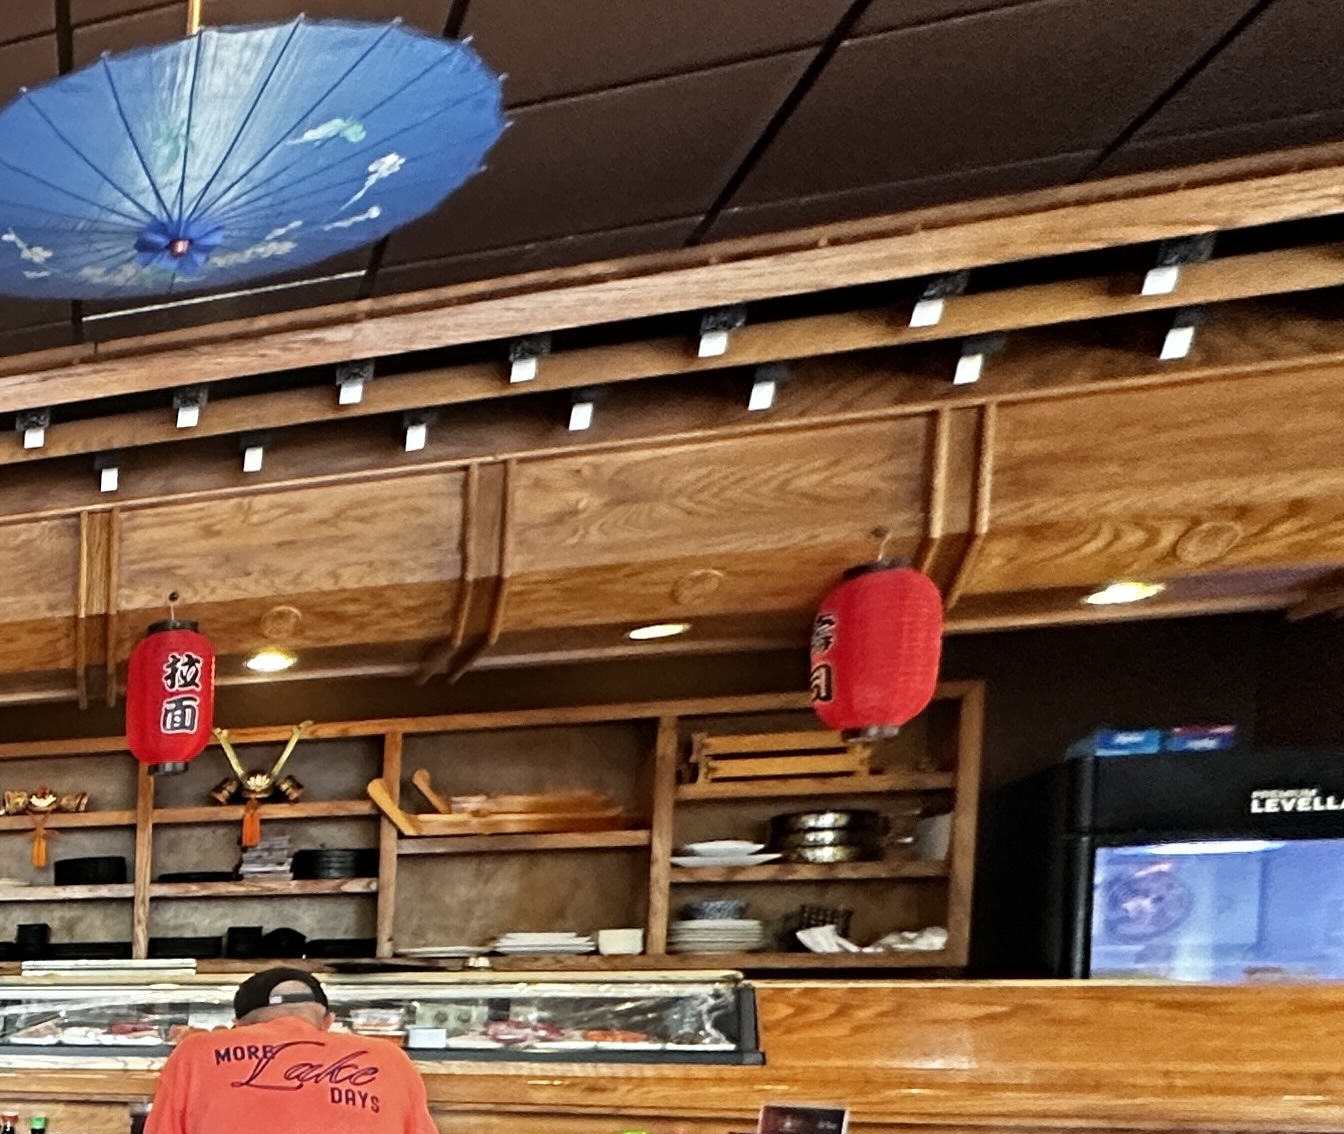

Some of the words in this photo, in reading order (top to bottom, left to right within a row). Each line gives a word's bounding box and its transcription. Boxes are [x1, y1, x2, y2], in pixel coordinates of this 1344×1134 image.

[162, 653, 202, 733] 拉面
[1251, 796, 1344, 813] LEVELL
[215, 1045, 275, 1065] MORE
[231, 1041, 378, 1091] Lake
[330, 1087, 380, 1114] DAYS
